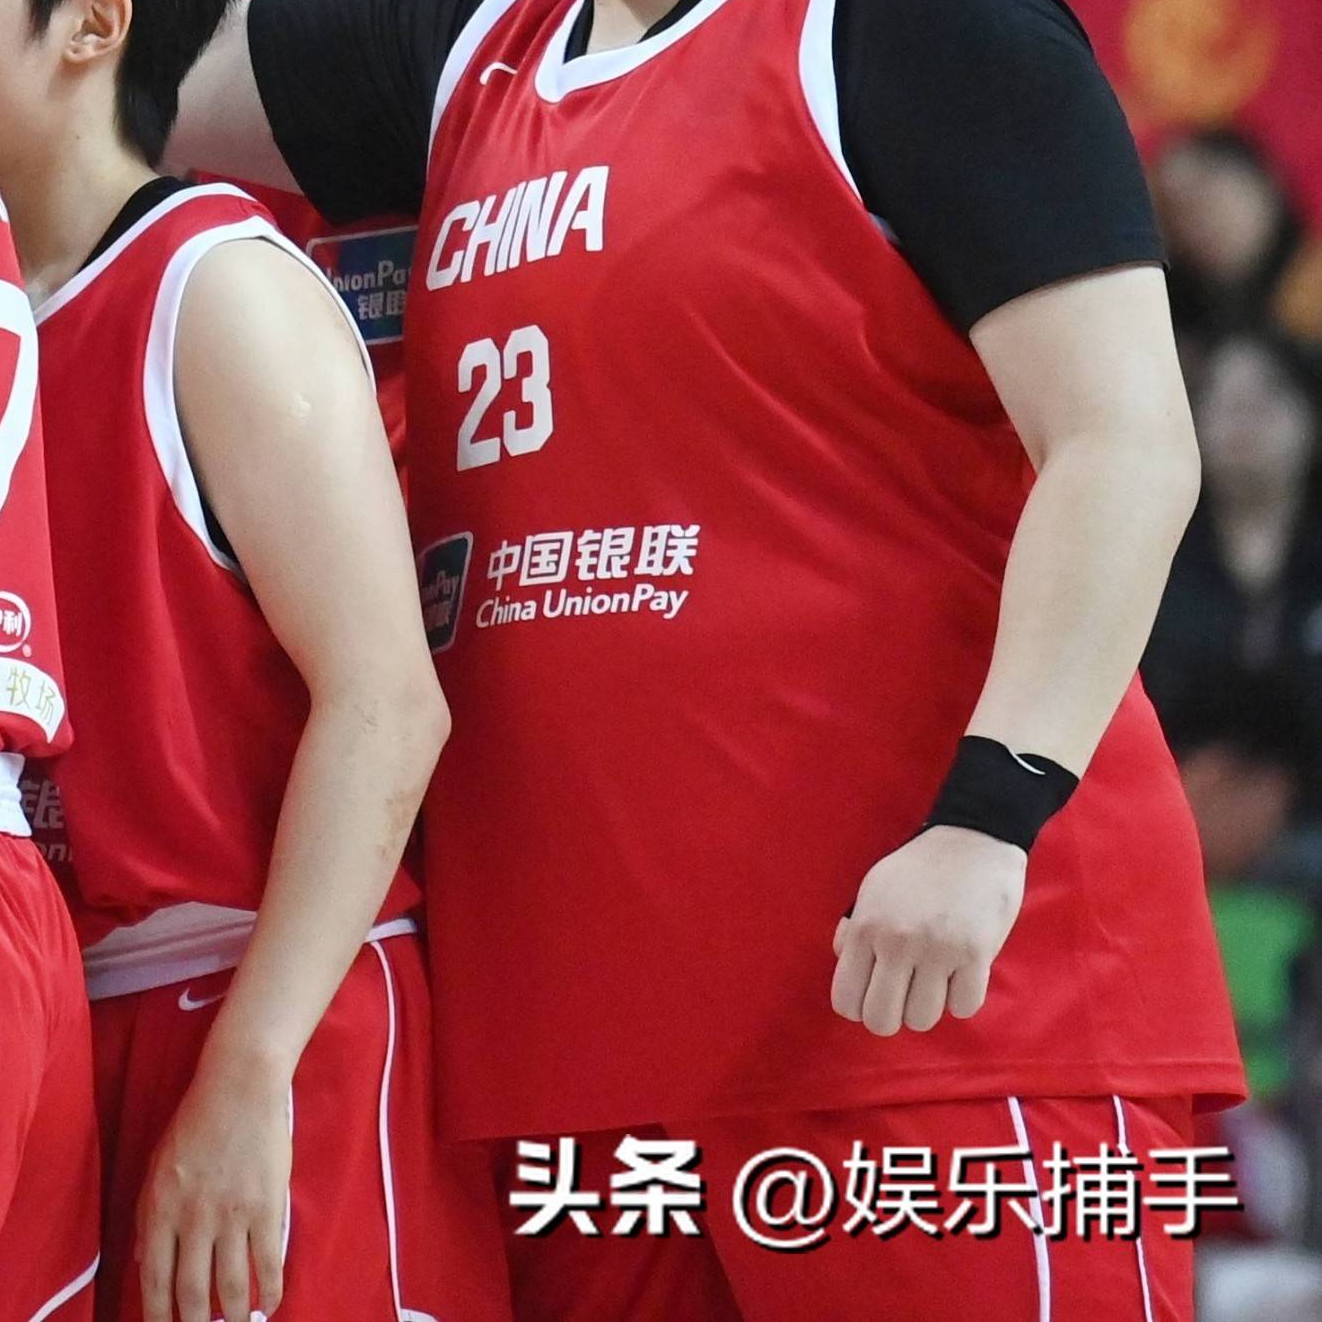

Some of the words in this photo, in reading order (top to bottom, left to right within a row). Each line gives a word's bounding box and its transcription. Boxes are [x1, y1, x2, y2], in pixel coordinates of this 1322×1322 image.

[426, 165, 609, 292] CHINA
[457, 324, 554, 472] 23
[475, 595, 537, 629] China
[542, 583, 690, 620] UnionPay
[487, 524, 701, 591] 中国银联
